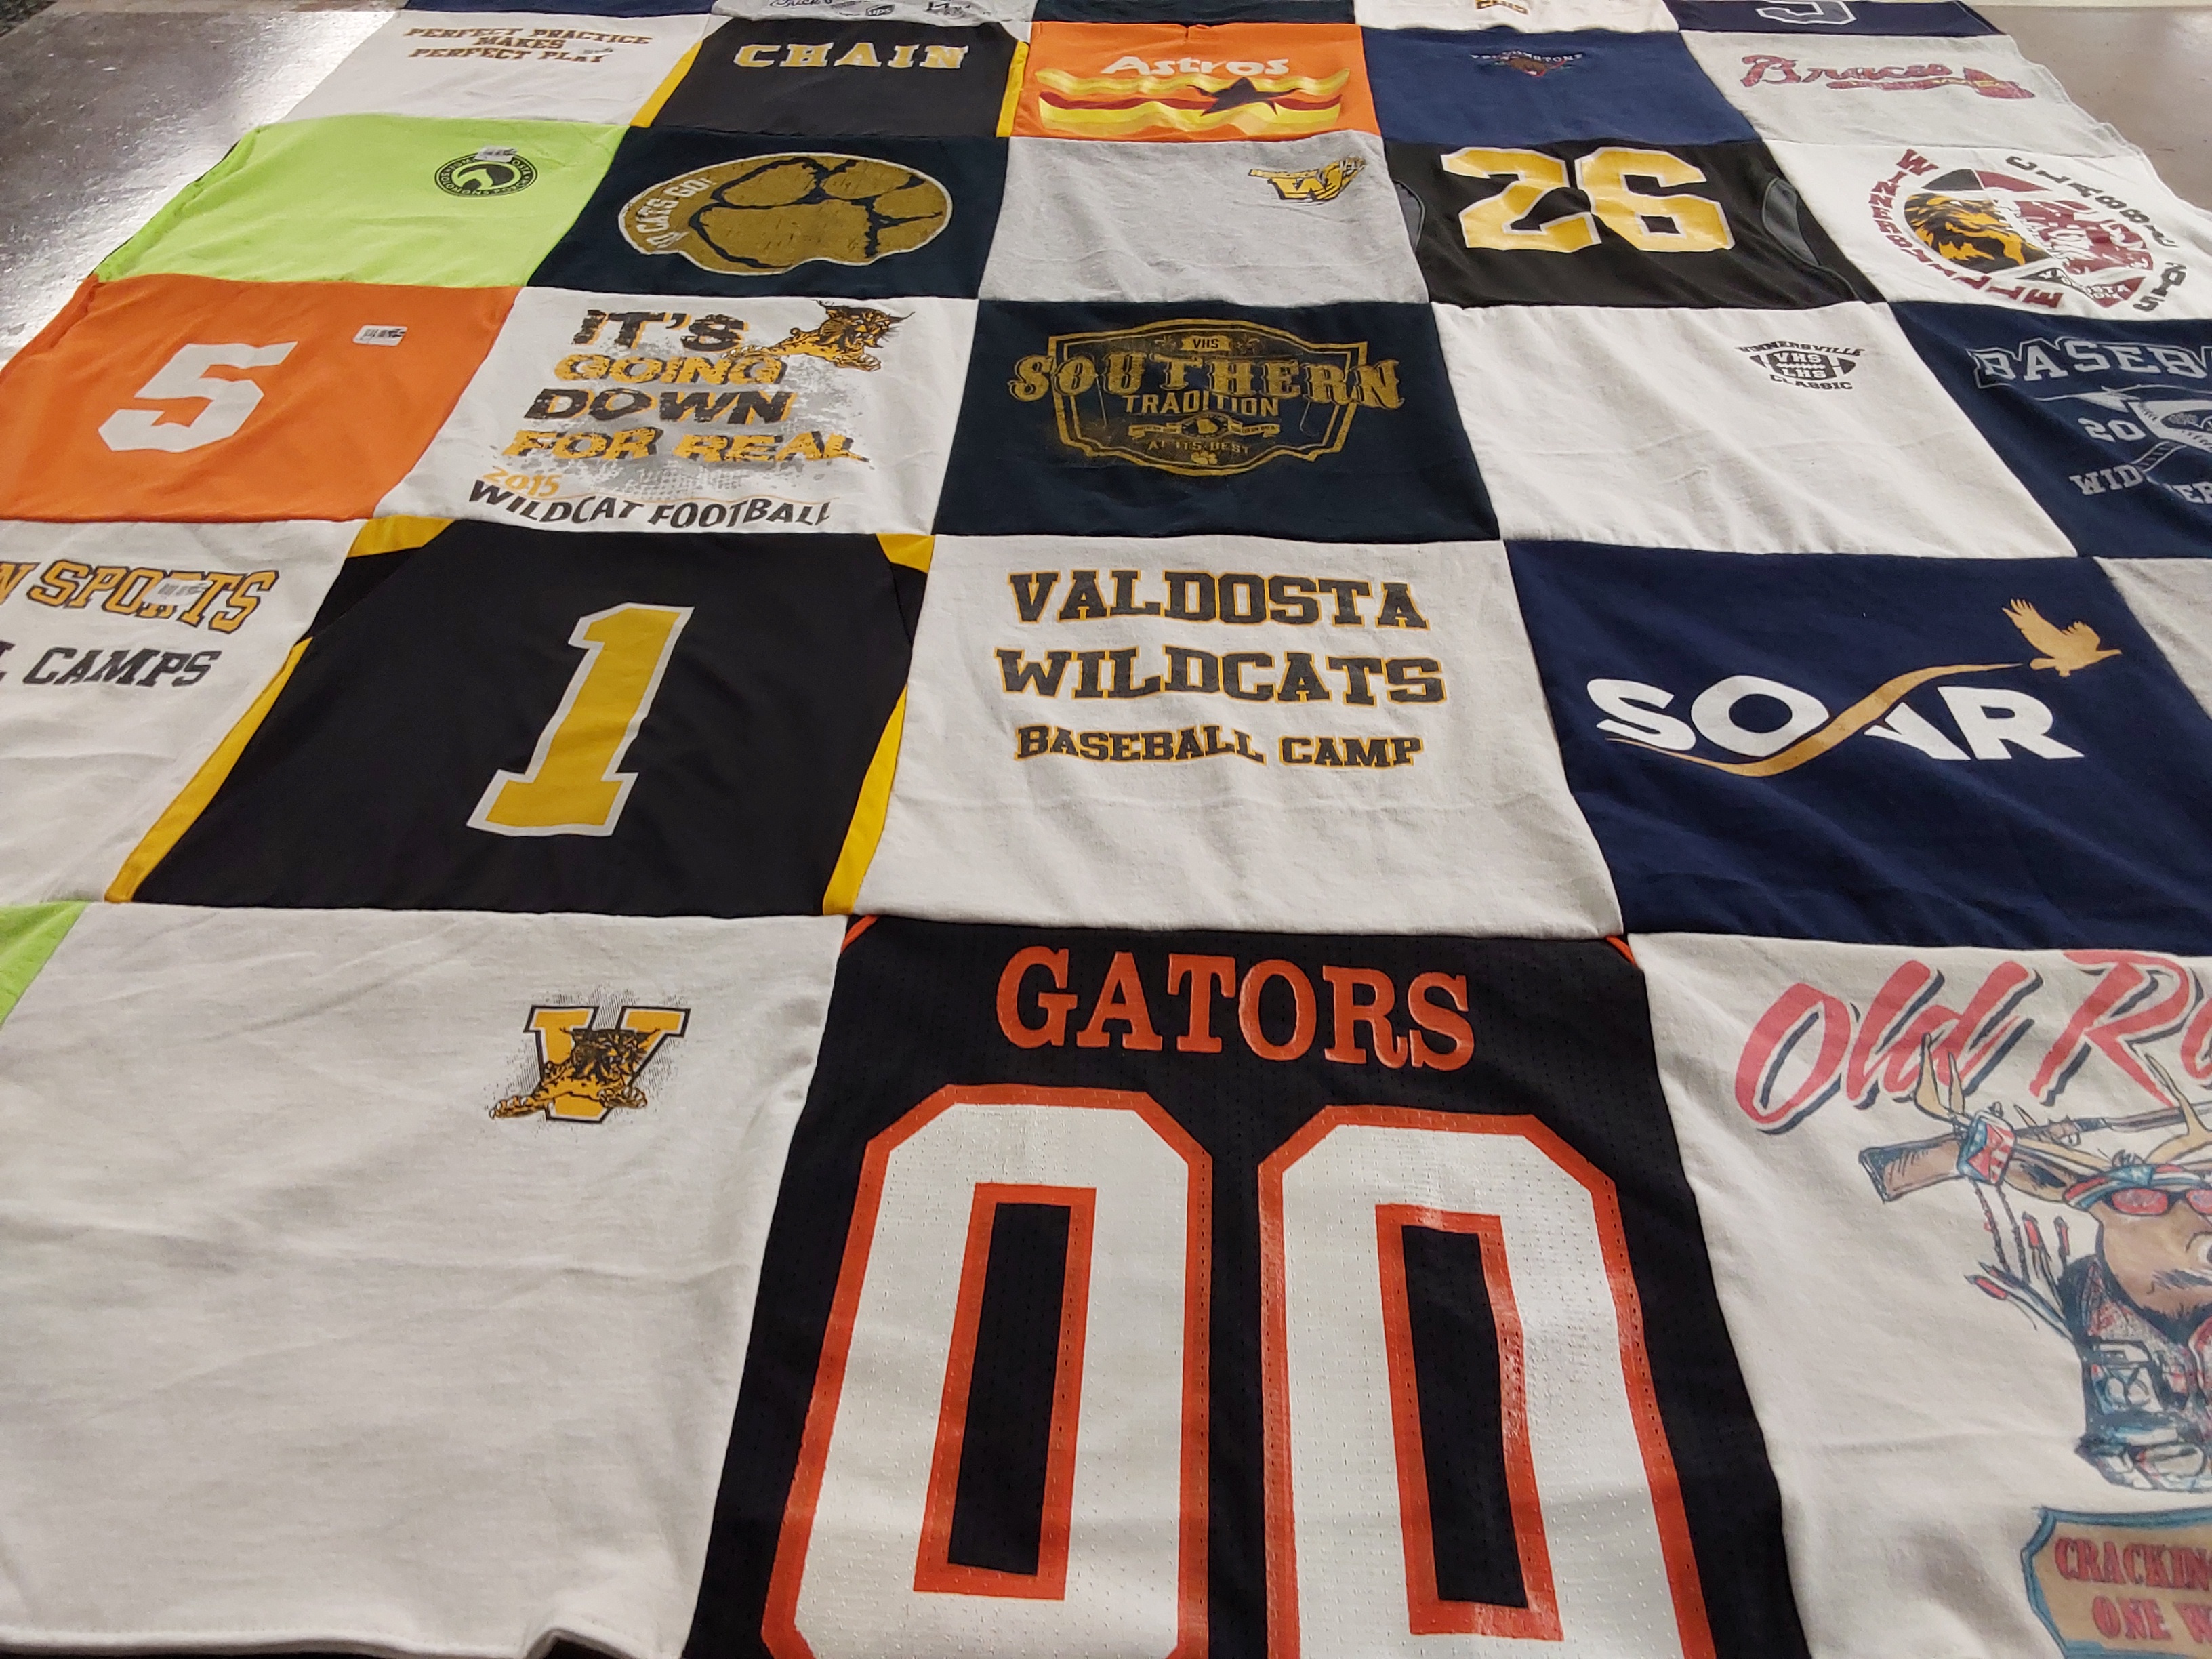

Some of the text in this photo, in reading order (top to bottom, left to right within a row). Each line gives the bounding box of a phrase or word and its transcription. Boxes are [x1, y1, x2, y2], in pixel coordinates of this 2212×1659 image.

[404, 28, 653, 45] PERFECT PRACTICE
[408, 48, 532, 60] PERFECT
[474, 37, 565, 49] MAKES
[733, 42, 969, 68] CHAIN
[1100, 56, 1290, 76] Astros
[1440, 146, 1736, 253] 26
[2005, 155, 2180, 248] CLASSIC
[572, 309, 749, 352] IT'S
[1193, 339, 1218, 348] VHS
[554, 354, 790, 385] GOING
[1773, 352, 1823, 363] VHS
[1781, 368, 1828, 379] LHS
[1973, 339, 2212, 382] BASEB
[98, 340, 298, 453] 5
[1008, 350, 1406, 410] SOUTHERN
[1769, 374, 1853, 390] CLASSIC
[523, 387, 798, 424] DOWN
[1121, 390, 1280, 417] TRADITION
[501, 426, 871, 463] FOR REAL
[2077, 417, 2147, 442] 20
[468, 478, 832, 528] WILDCAT FOOTBALL
[482, 466, 563, 498] 2015
[1006, 568, 1431, 630] VALDOSTA
[22, 647, 223, 688] CAMPS
[994, 644, 1448, 708] WILDCATS
[466, 601, 695, 838] 1
[1586, 675, 2085, 762] SOAR
[1013, 722, 1425, 771] BASEBALL CAMP
[996, 943, 1475, 1072] GATORS
[1734, 959, 2044, 1136] Old
[2053, 1536, 2212, 1591] CRACKIN
[2091, 1594, 2173, 1641] ONE
